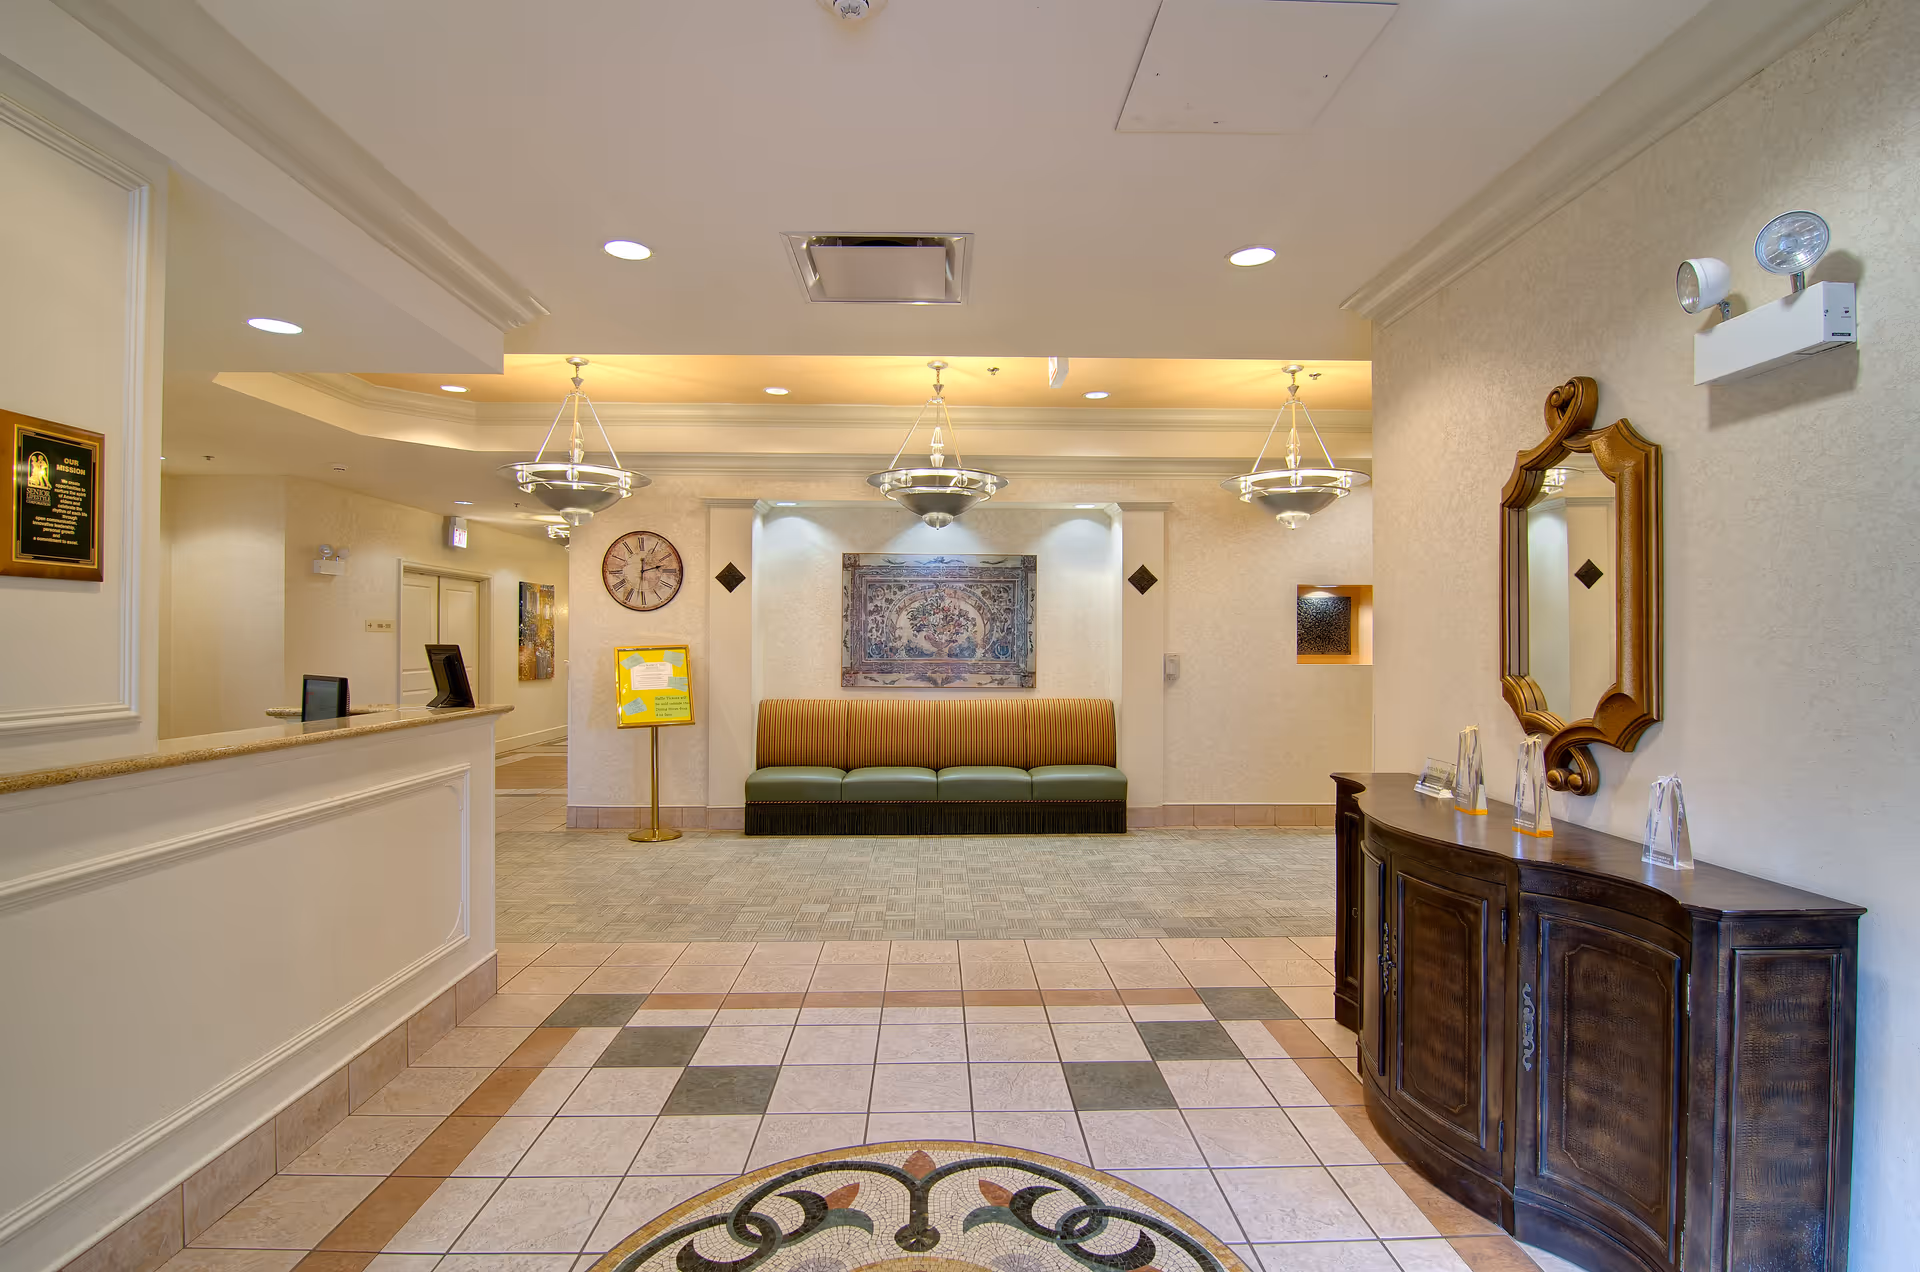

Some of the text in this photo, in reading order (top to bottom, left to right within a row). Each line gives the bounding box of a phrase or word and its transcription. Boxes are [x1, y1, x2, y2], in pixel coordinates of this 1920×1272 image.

[64, 458, 79, 466] OUR
[56, 464, 86, 476] MISSION
[26, 487, 50, 497] SENIOR
[456, 528, 466, 546] EXIT
